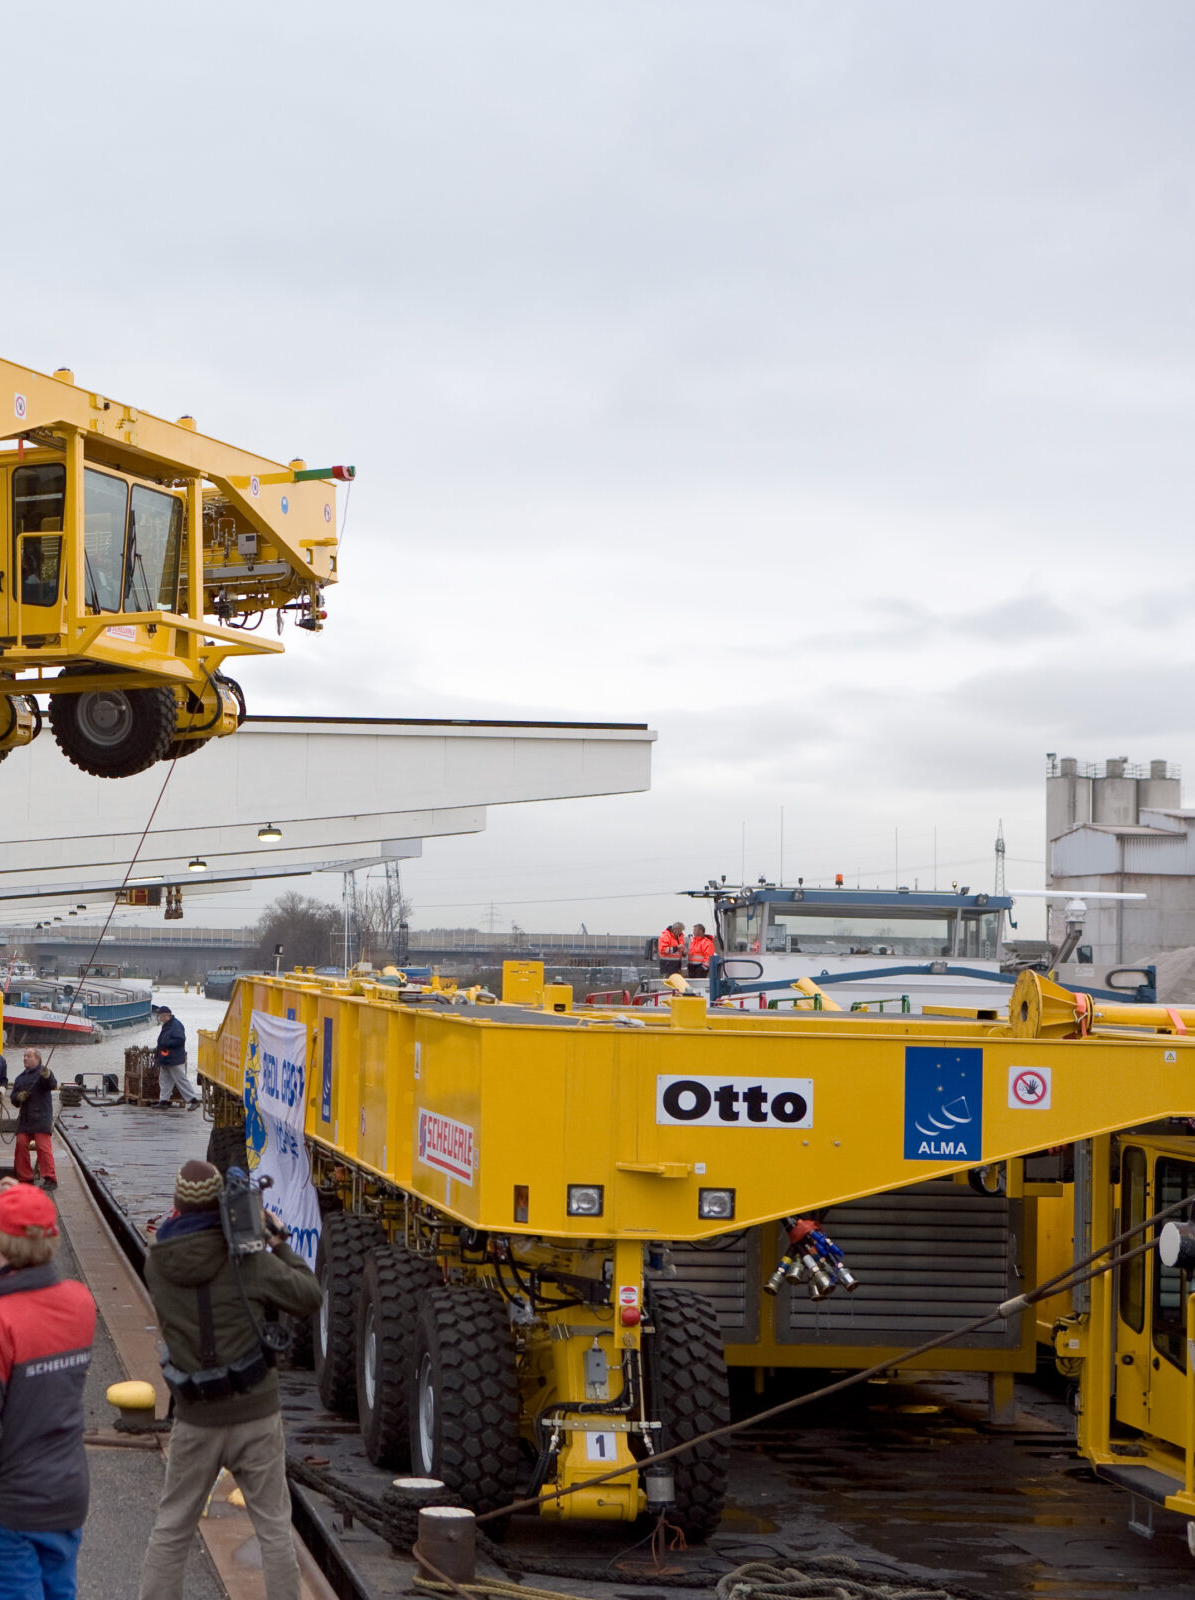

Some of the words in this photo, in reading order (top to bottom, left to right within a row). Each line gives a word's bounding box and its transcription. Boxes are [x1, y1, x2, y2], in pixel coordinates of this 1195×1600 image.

[662, 1079, 808, 1123] Otto
[426, 1115, 473, 1167] SCHEUERLE
[917, 1140, 968, 1156] ALMA
[595, 1434, 606, 1458] 1
